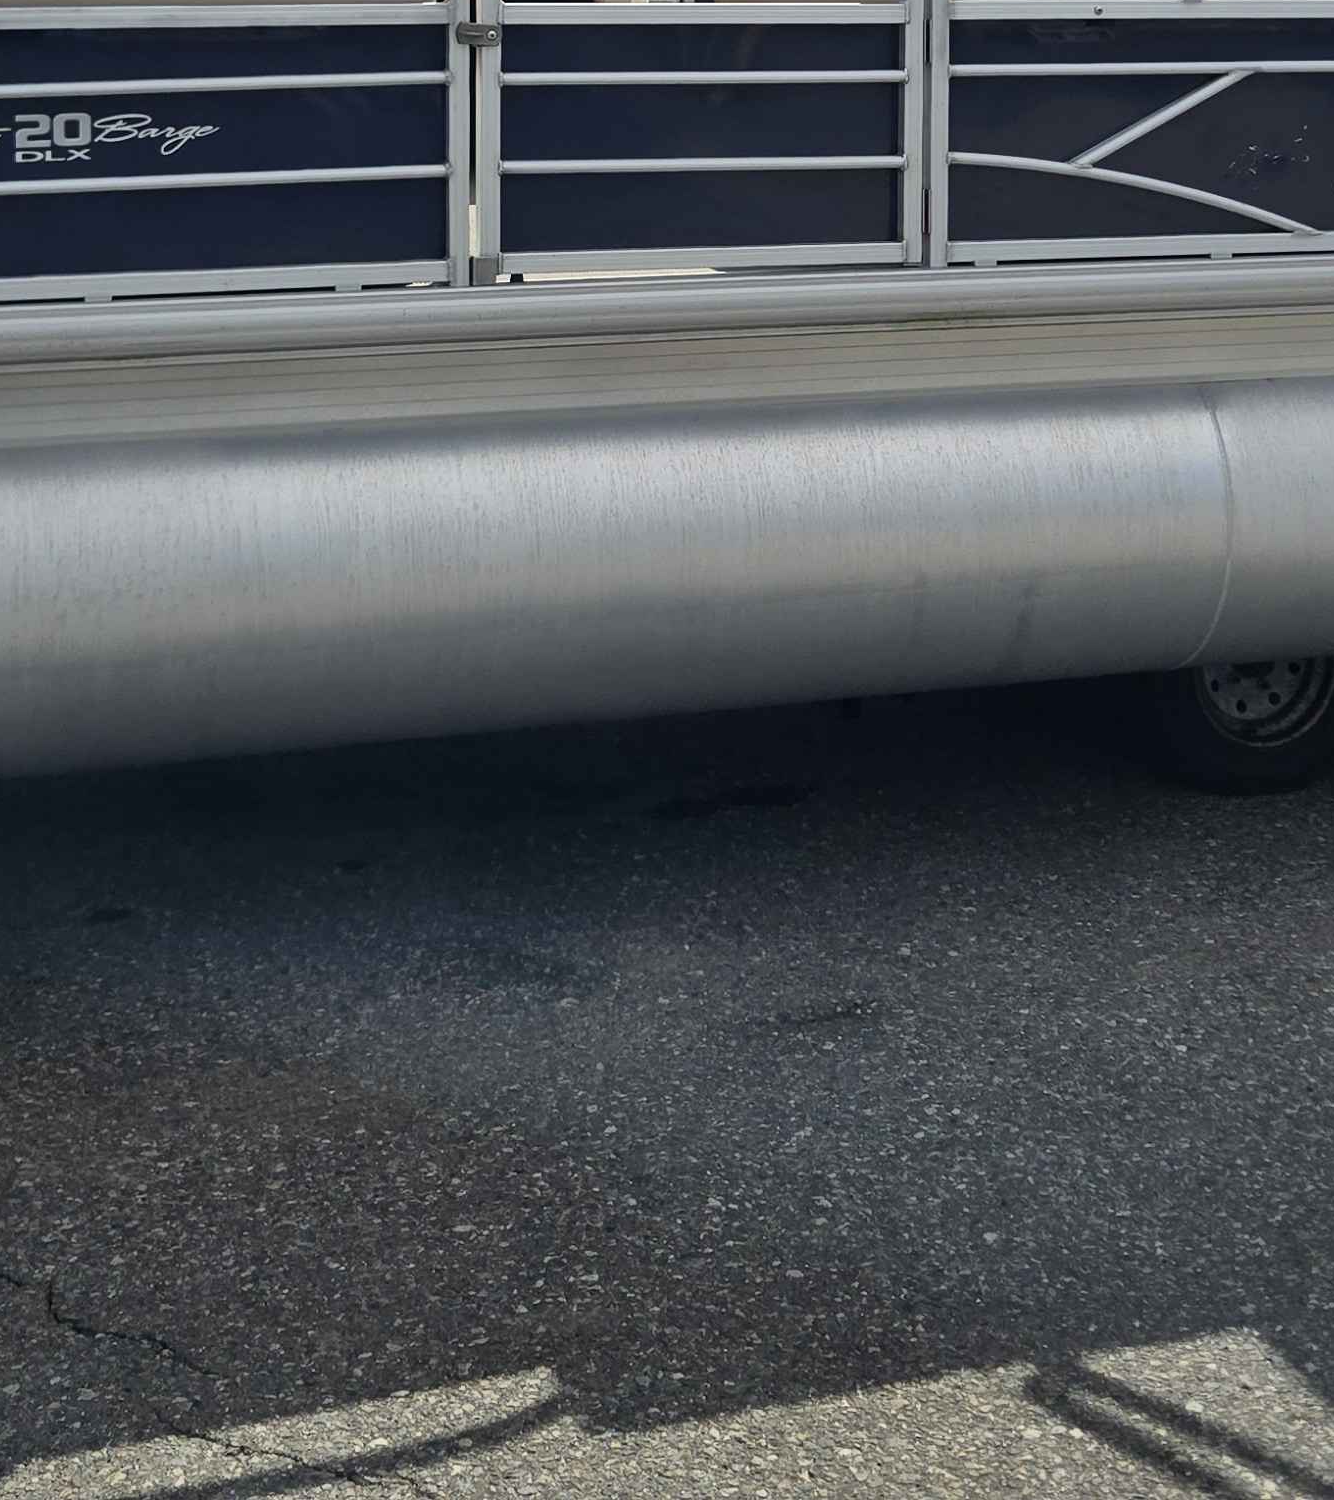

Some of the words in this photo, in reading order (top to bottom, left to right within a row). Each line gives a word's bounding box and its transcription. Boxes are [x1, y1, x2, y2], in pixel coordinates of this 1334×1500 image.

[15, 112, 91, 148] 20
[93, 113, 220, 155] Barge
[15, 149, 91, 163] DLX
